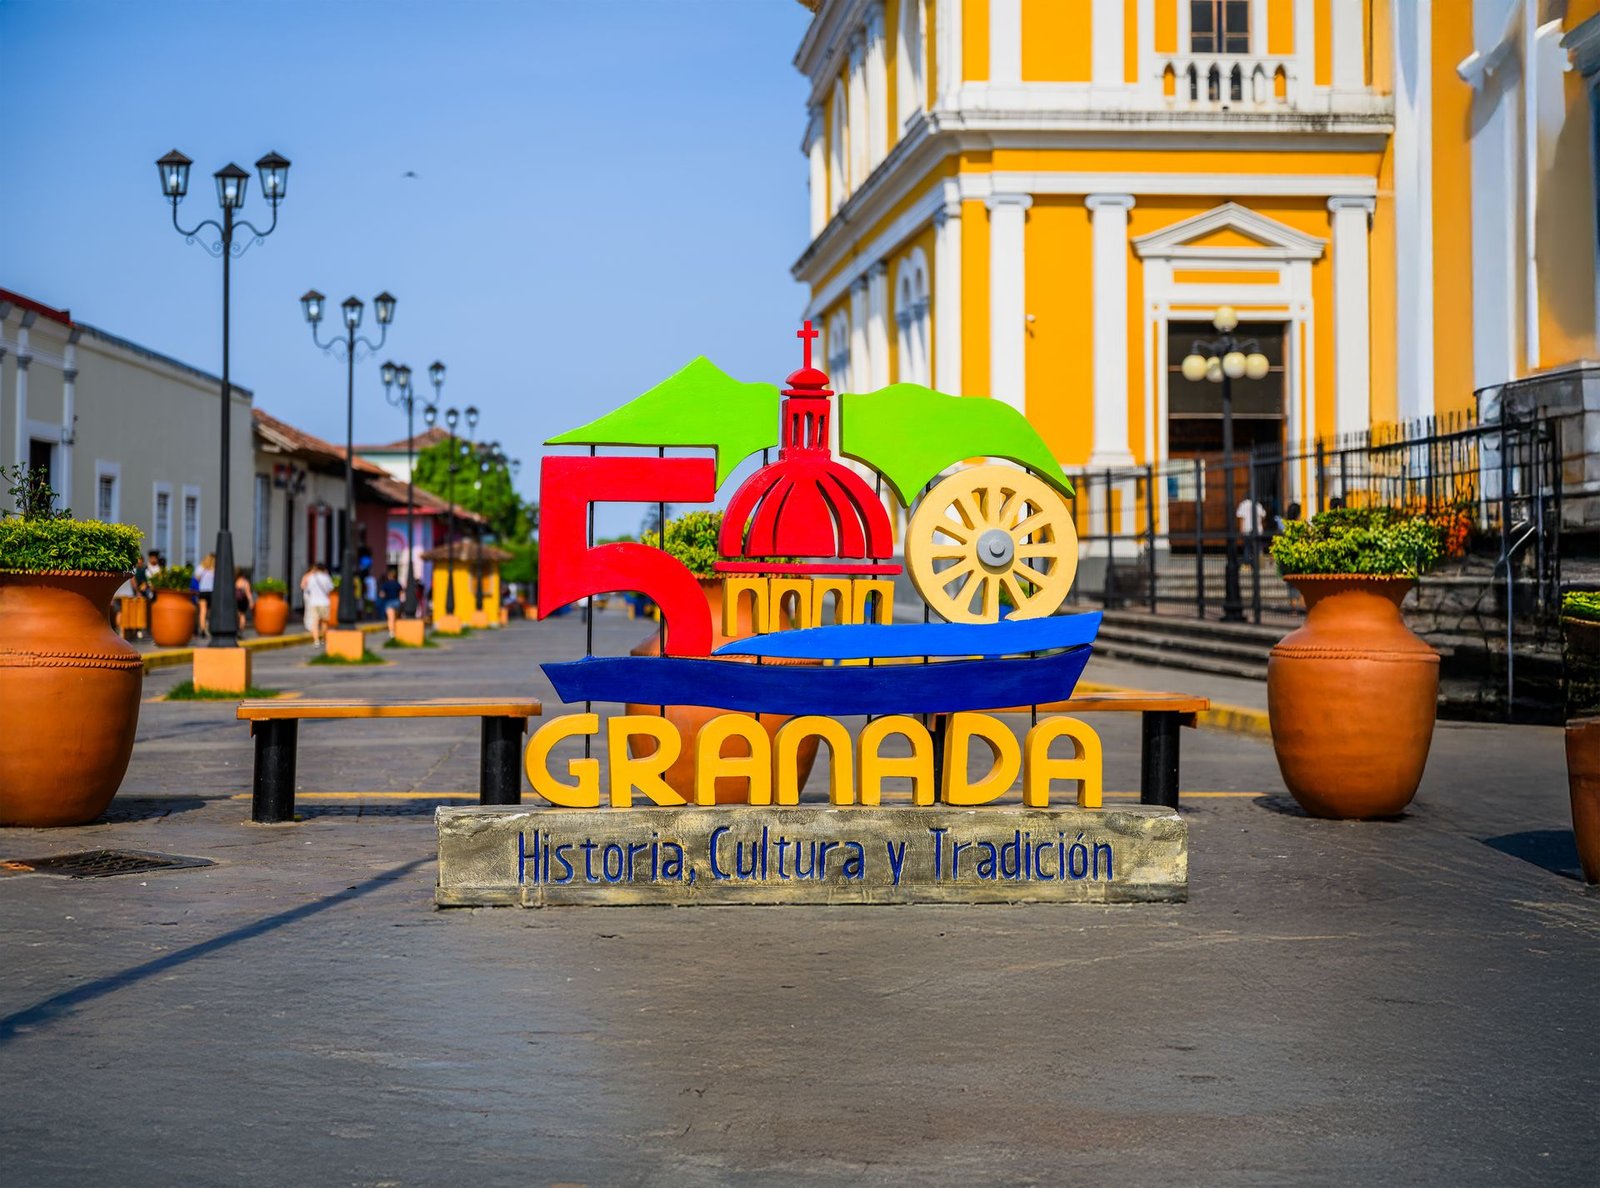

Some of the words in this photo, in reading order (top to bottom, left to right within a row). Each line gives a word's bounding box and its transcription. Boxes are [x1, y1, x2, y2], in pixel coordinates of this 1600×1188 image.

[525, 713, 1103, 808] GRANADA
[518, 829, 696, 885] Historia,
[709, 826, 865, 881] Cultura
[887, 841, 905, 885] y
[929, 828, 1113, 881] Tradición
